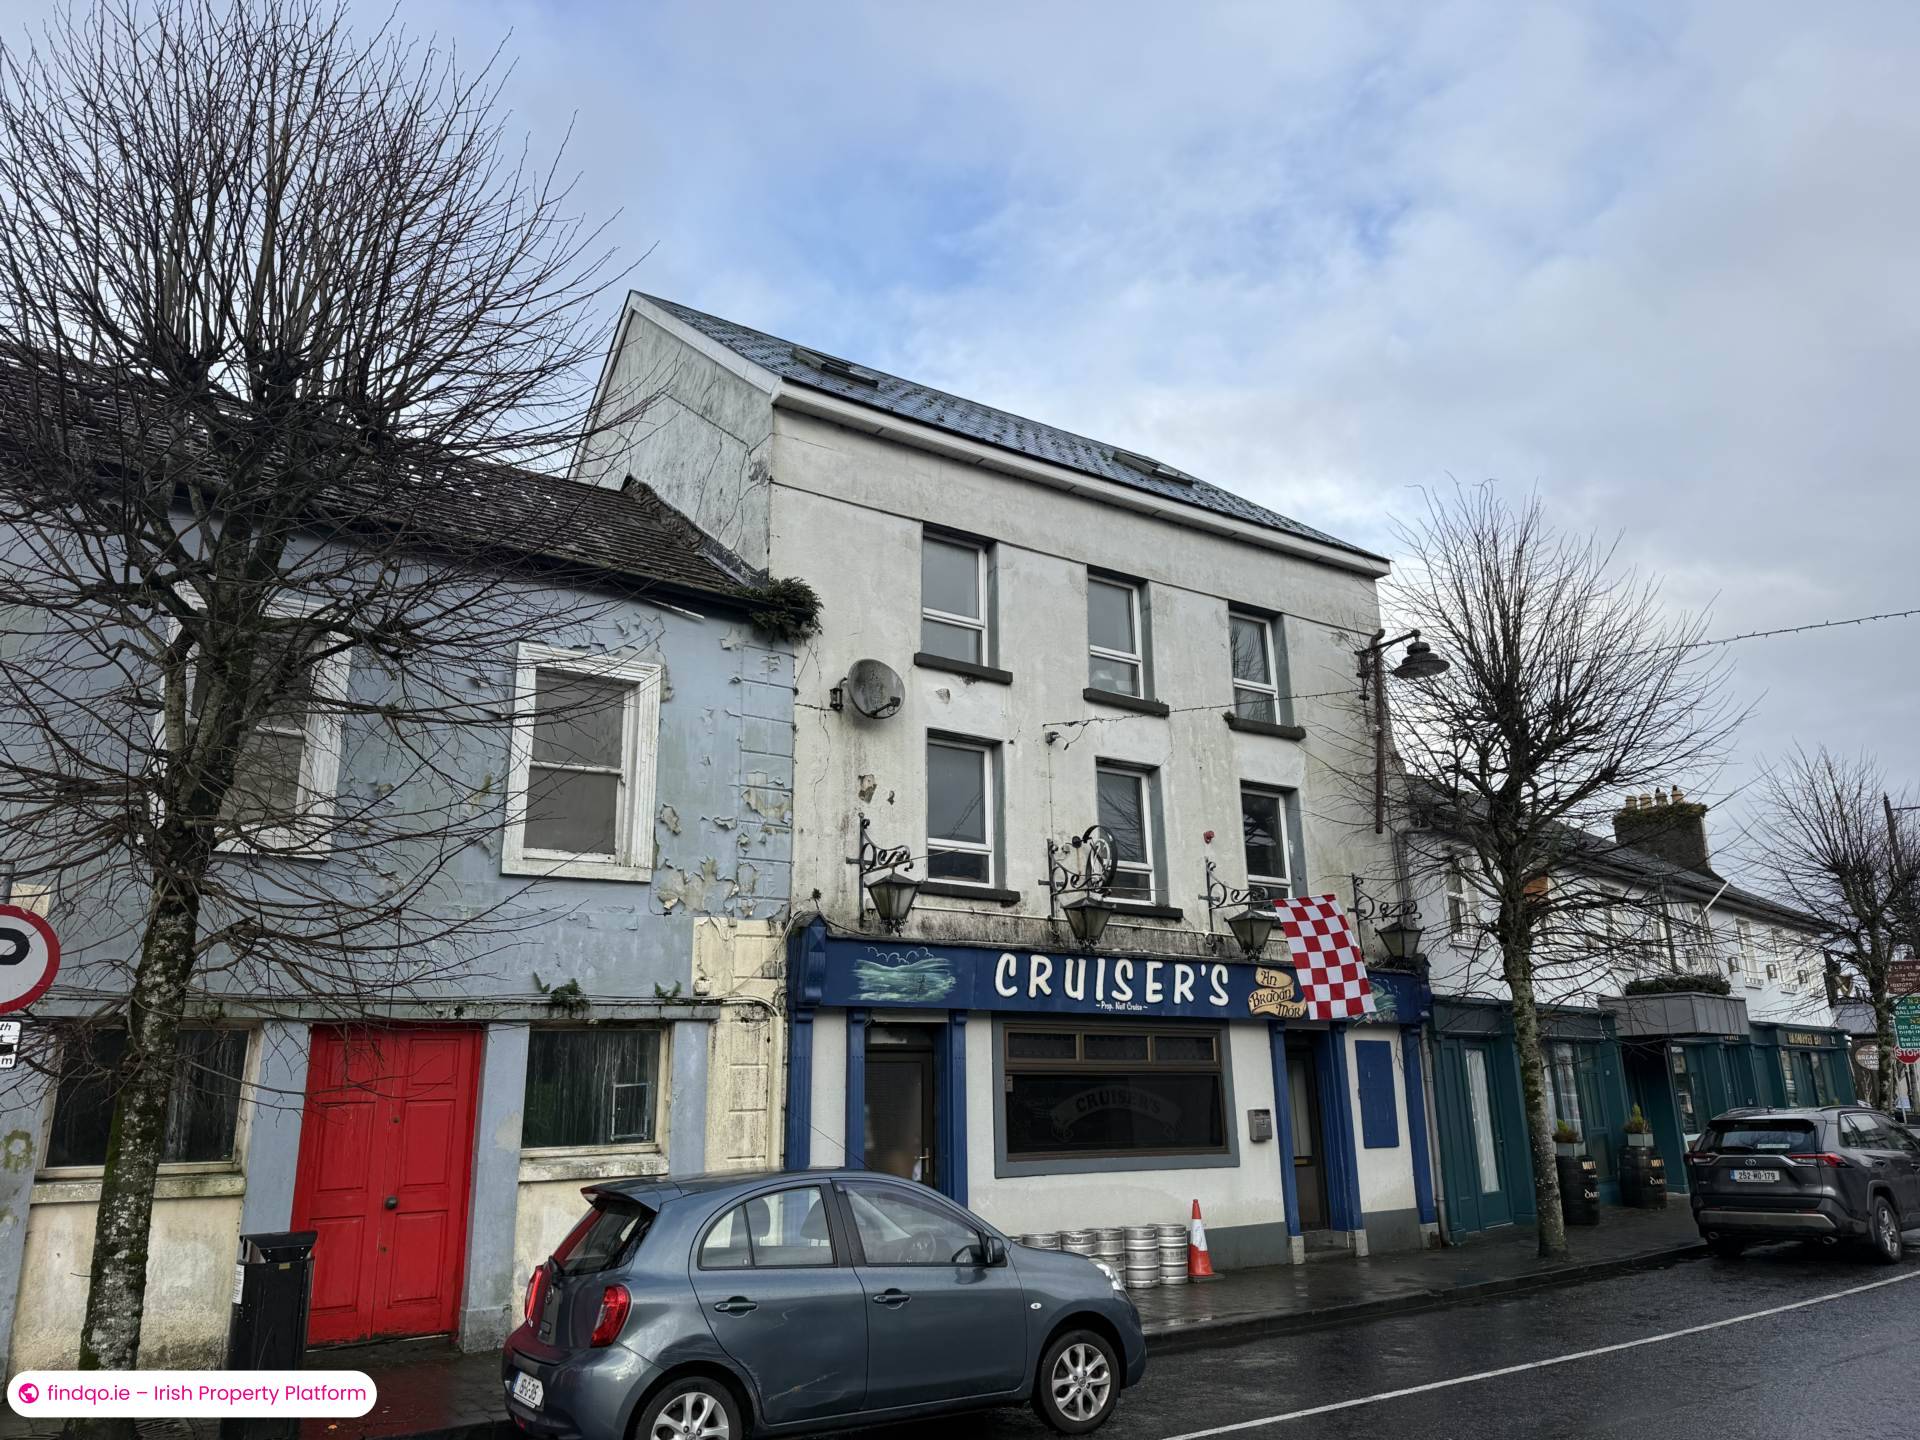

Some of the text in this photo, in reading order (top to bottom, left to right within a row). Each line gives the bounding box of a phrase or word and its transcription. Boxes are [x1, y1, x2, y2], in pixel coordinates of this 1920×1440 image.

[994, 953, 1229, 1006] CRUISER'S
[1260, 970, 1277, 986] An
[1895, 1048, 1919, 1057] STOP
